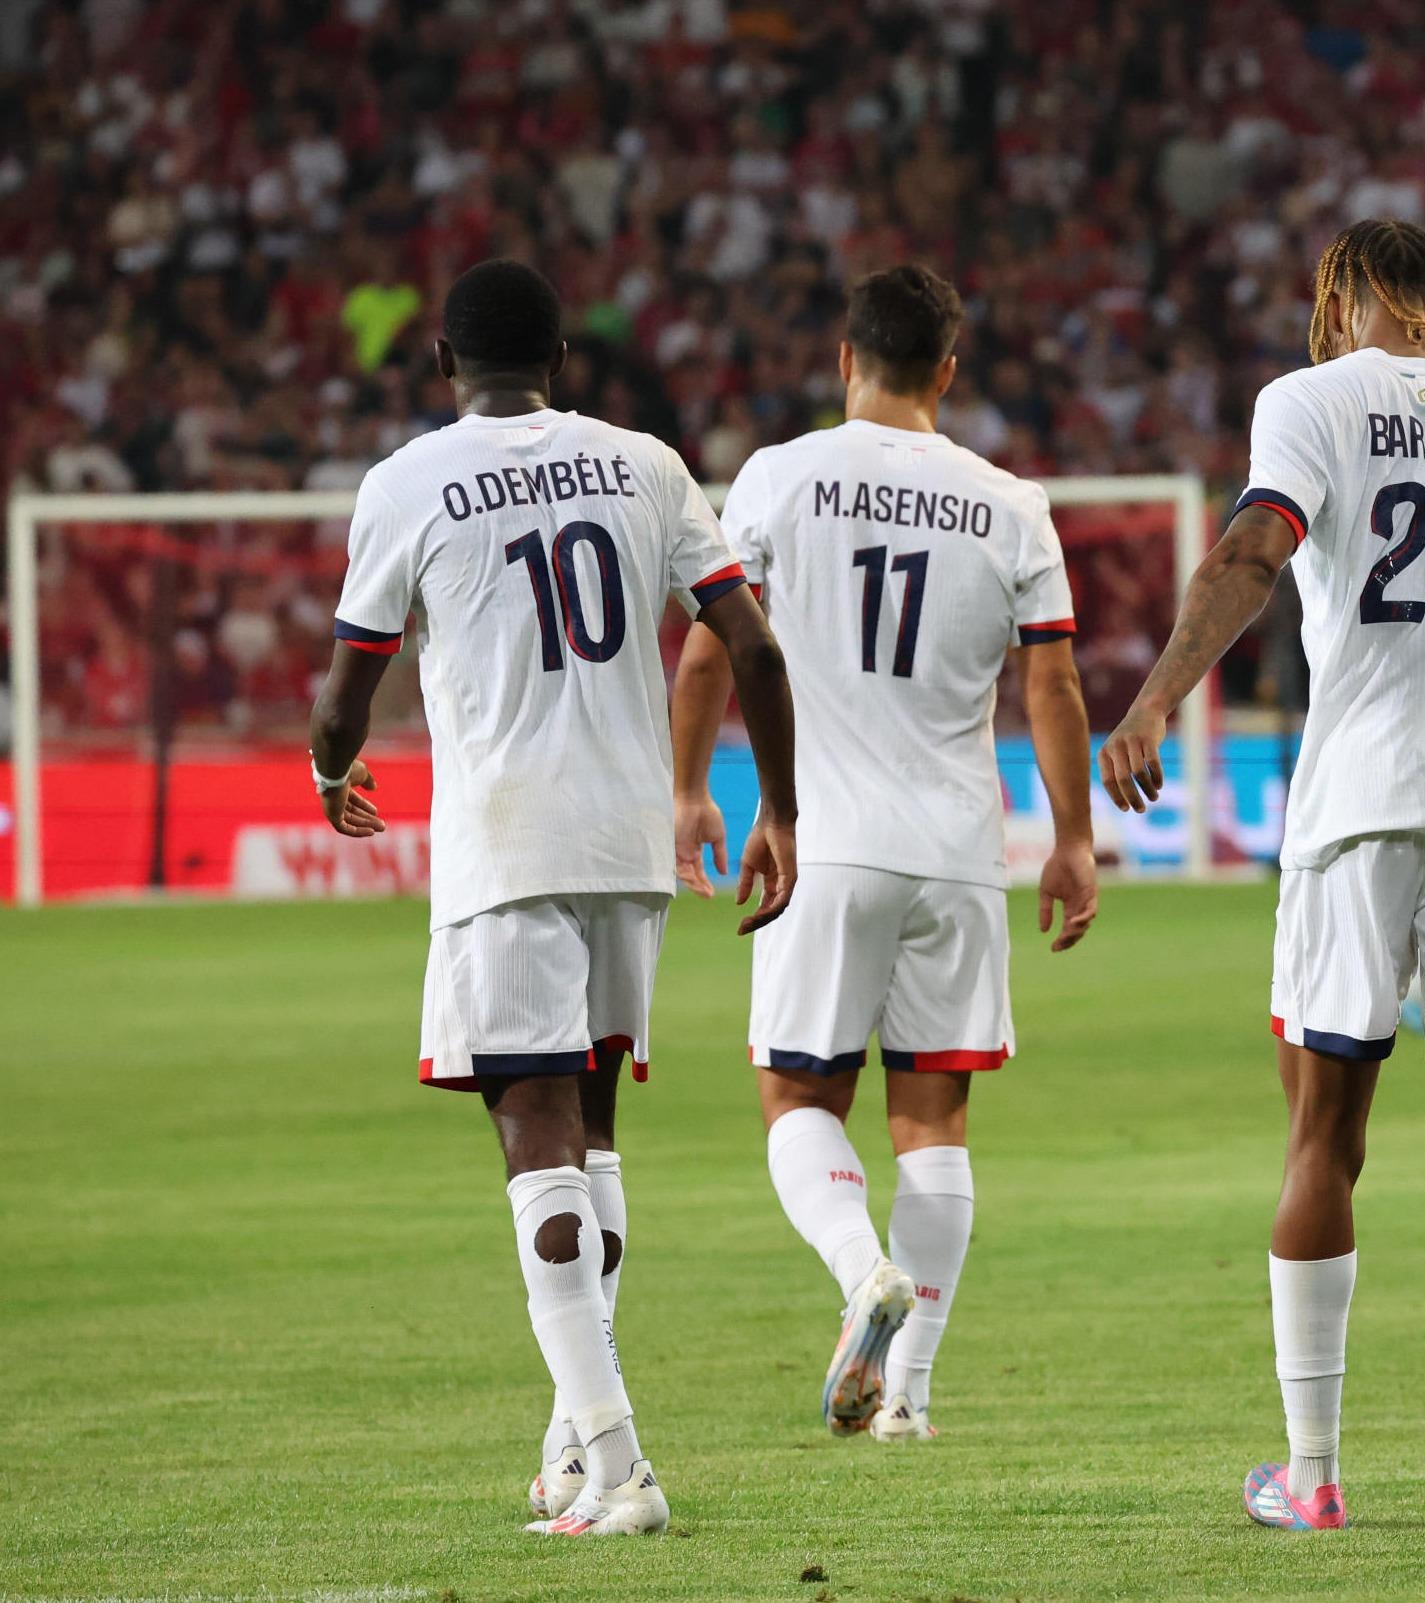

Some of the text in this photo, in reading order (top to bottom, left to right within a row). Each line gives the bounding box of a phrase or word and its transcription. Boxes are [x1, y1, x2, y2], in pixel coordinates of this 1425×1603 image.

[442, 452, 635, 521] O.DEMBÉLÉ
[814, 481, 992, 538] M.ASENSIO
[505, 520, 626, 672] 10
[852, 545, 929, 678] 11
[829, 1170, 865, 1188] PARIS
[915, 1284, 941, 1302] RIS
